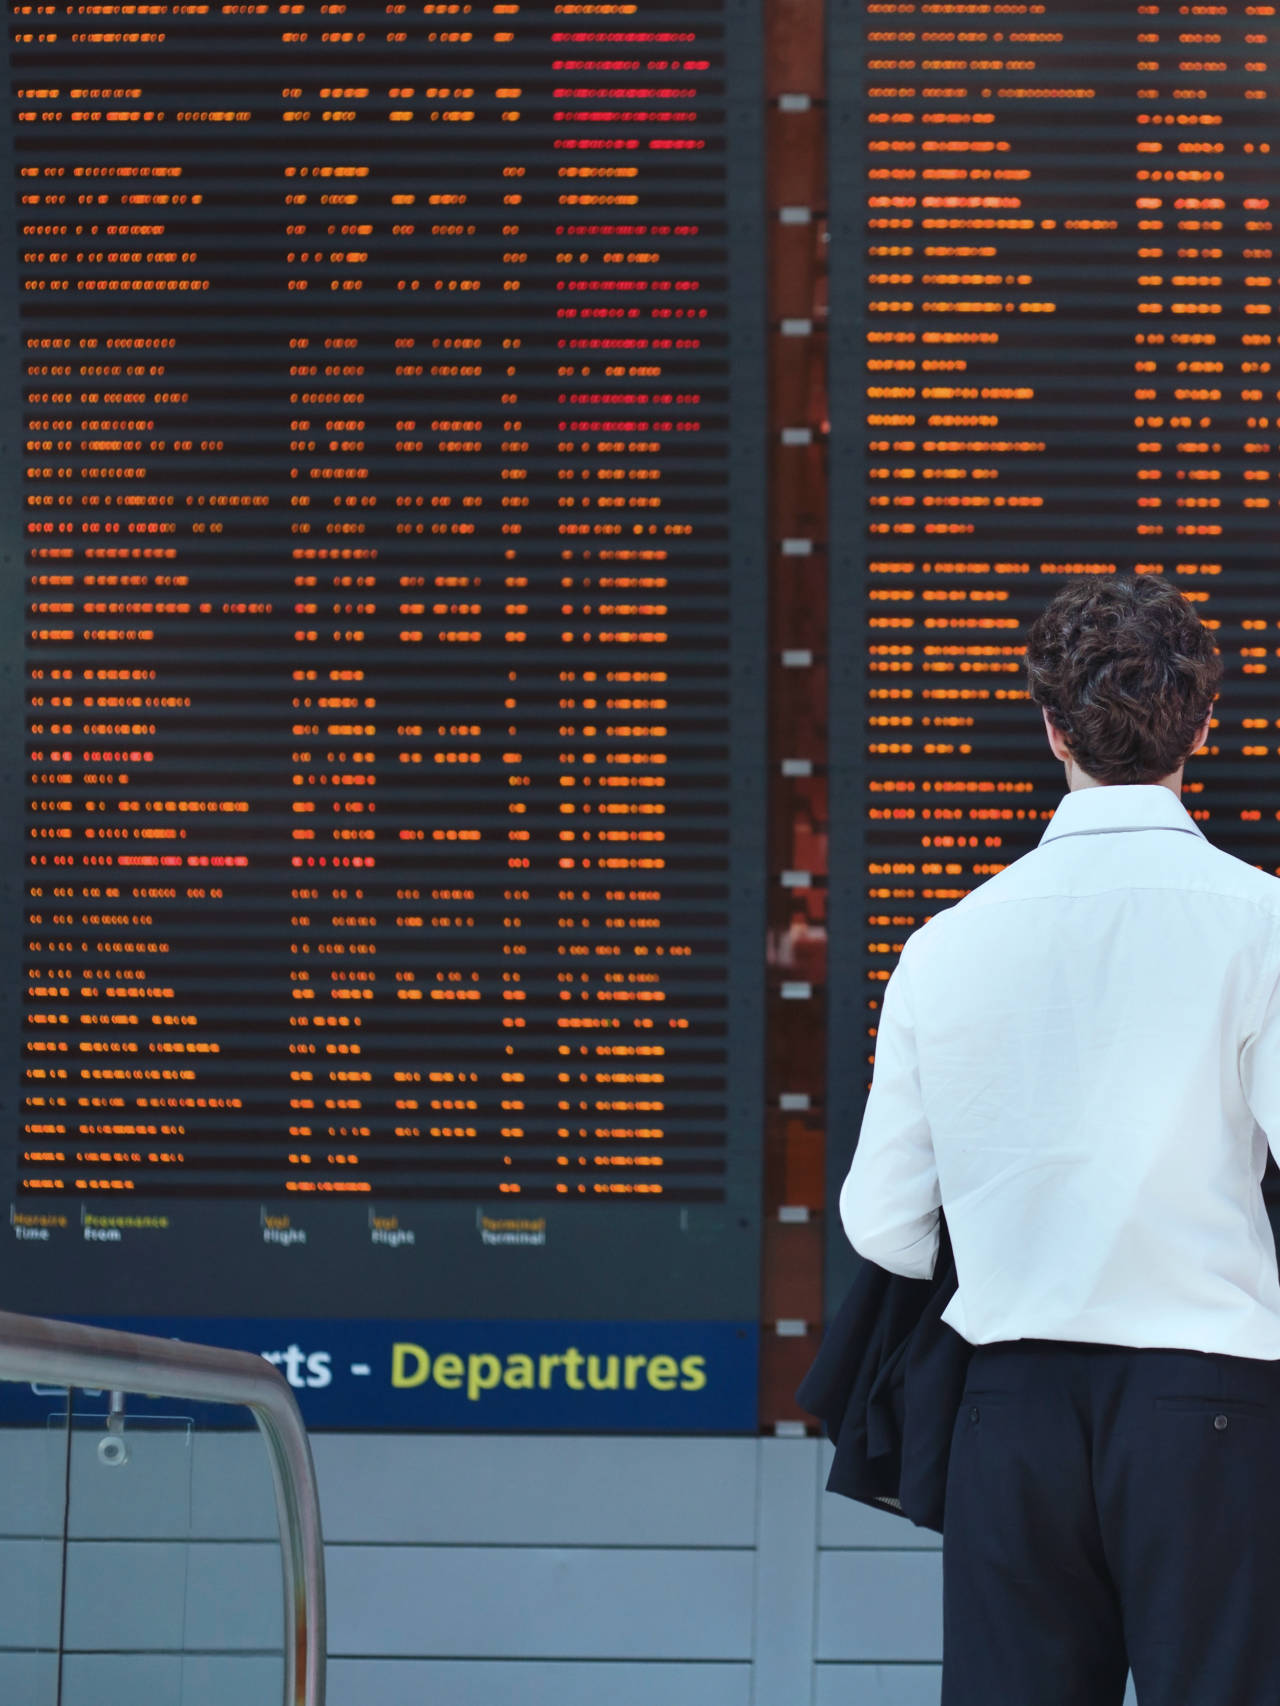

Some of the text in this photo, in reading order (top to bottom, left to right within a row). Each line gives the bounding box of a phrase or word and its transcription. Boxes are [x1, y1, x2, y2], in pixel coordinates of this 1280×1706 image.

[84, 1227, 121, 1241] From
[263, 1228, 306, 1246] Flight
[371, 1228, 415, 1247] Flight
[482, 1230, 546, 1245] Terminal
[391, 1342, 707, 1400] Departures
